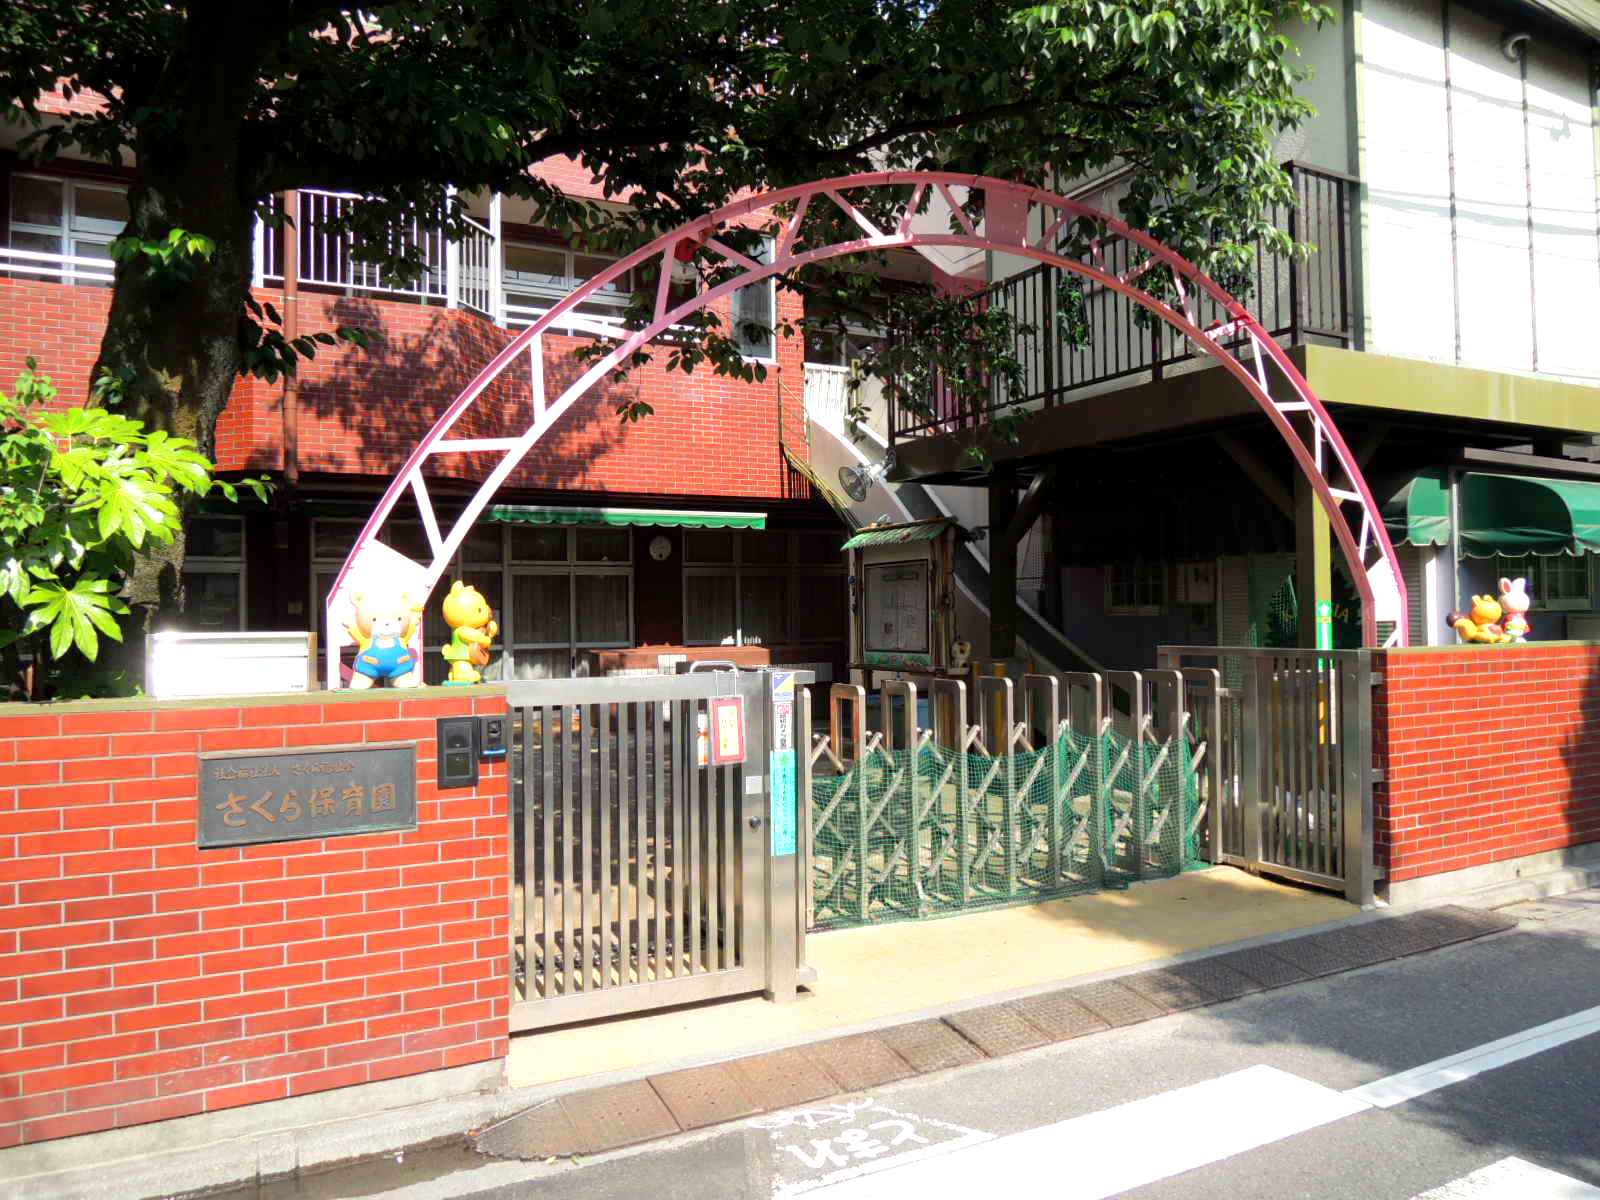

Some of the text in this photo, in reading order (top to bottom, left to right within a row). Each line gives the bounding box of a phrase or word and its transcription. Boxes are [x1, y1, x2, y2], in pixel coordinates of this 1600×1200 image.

[216, 783, 396, 828] さくら保育園
